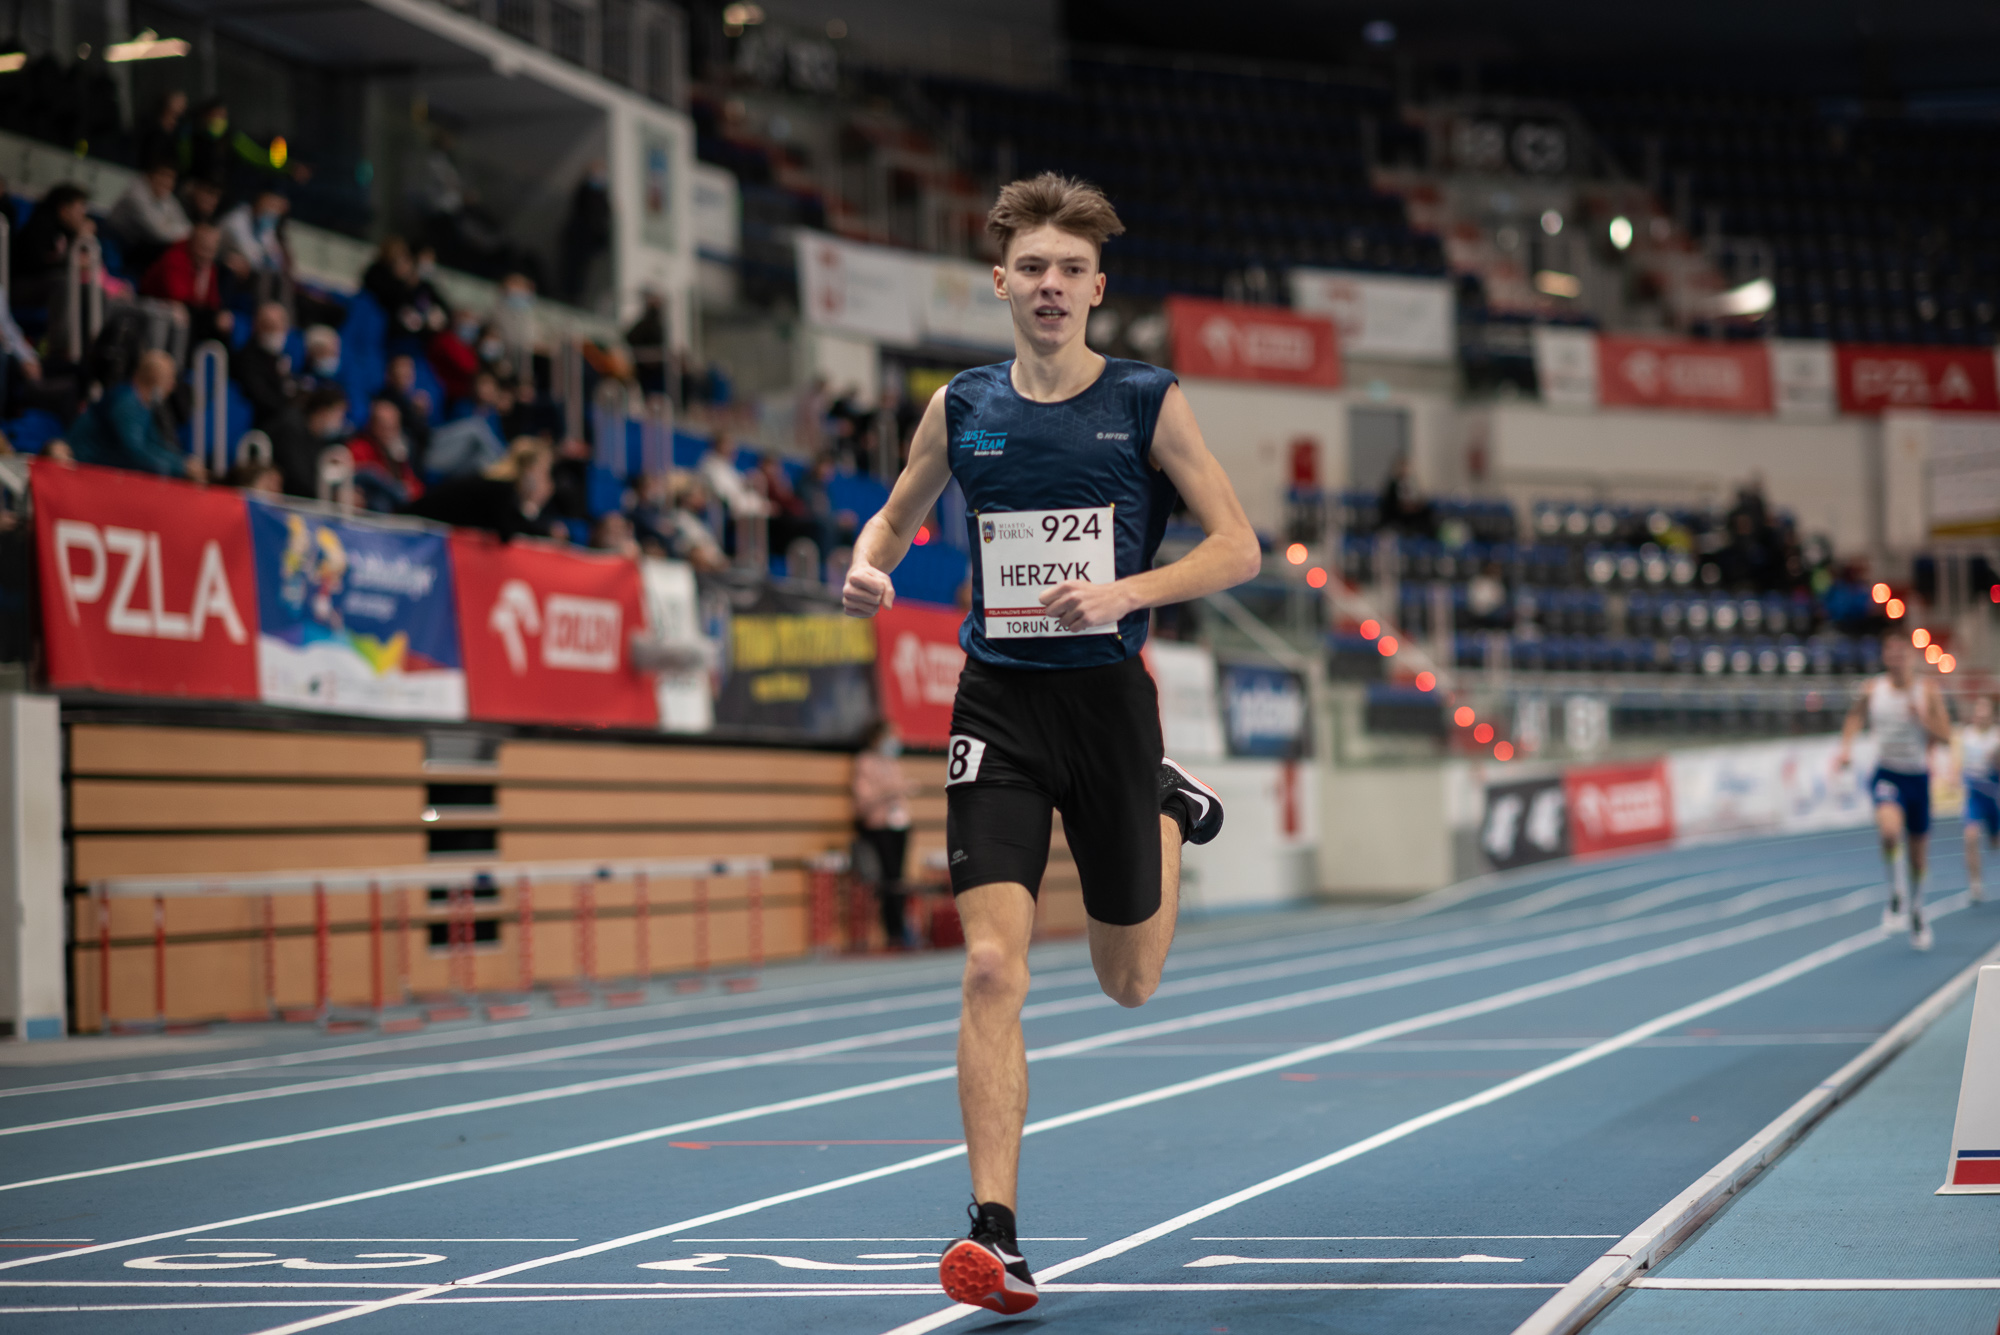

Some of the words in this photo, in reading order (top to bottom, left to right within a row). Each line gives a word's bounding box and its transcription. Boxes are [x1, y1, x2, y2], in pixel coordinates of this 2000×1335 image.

[961, 430, 986, 441] JUST
[976, 439, 1006, 450] TEAM
[998, 526, 1034, 540] TORUŃ
[1041, 512, 1102, 543] 924
[53, 518, 249, 646] PZLA
[1000, 561, 1092, 587] HERZYK
[1006, 617, 1049, 634] TORUŃ
[949, 739, 972, 780] 8
